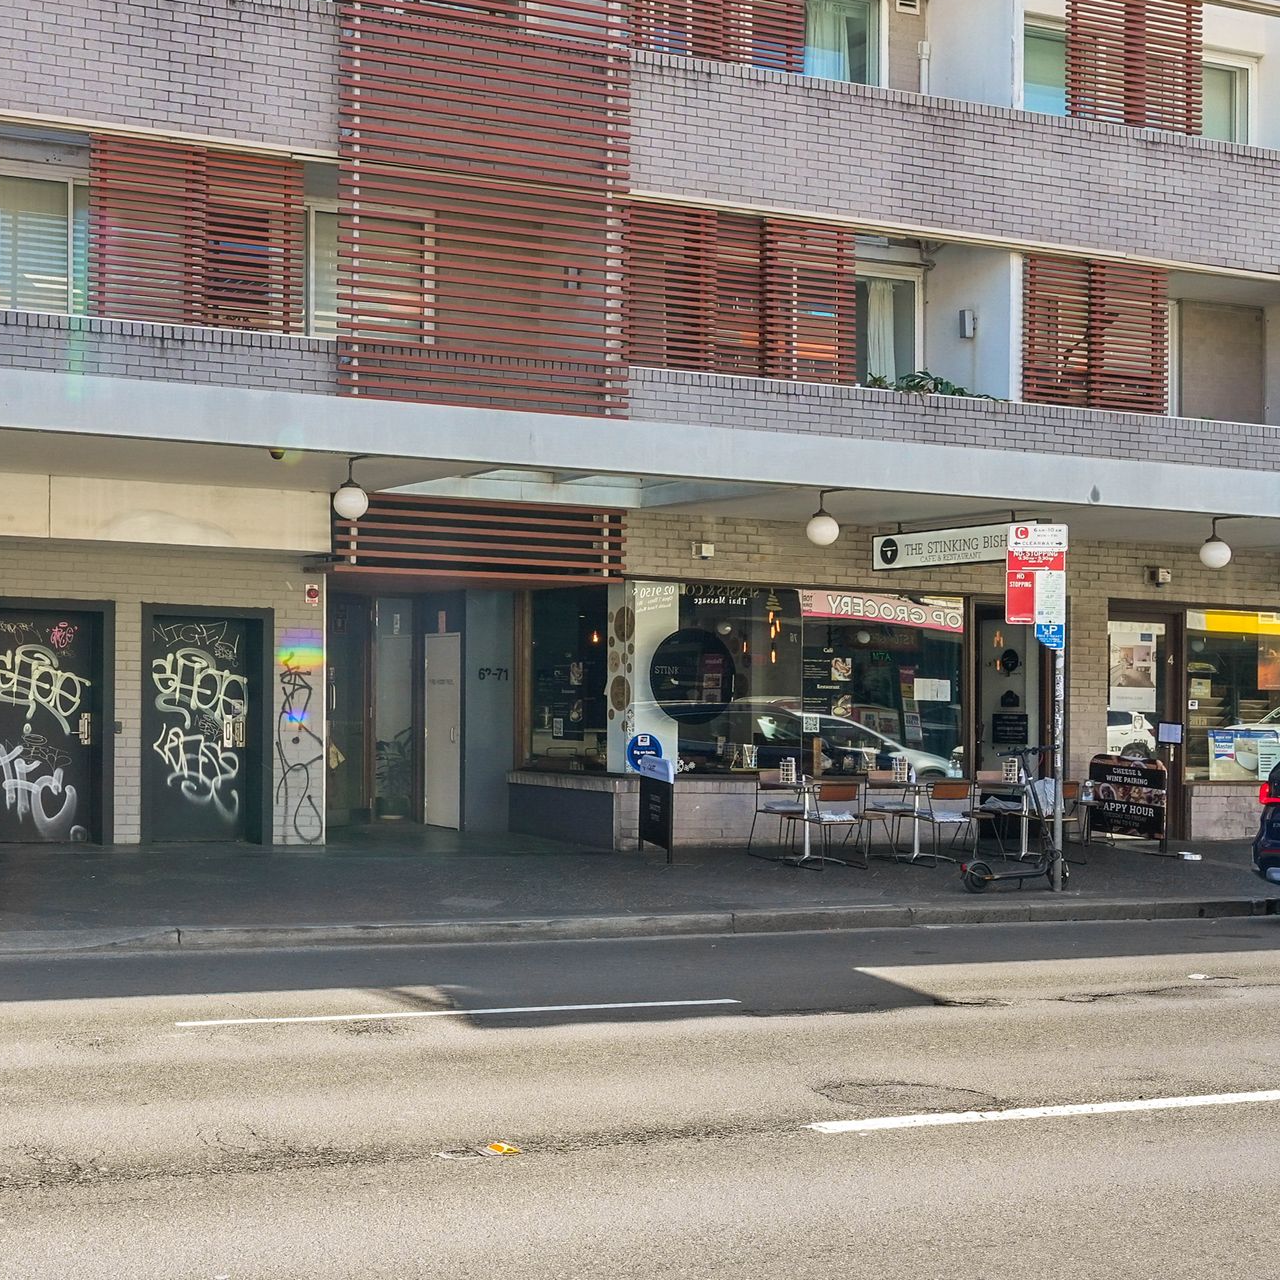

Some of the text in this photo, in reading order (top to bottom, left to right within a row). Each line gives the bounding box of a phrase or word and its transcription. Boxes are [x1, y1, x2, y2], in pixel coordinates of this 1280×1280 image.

[904, 533, 1008, 556] THE STINKING BISH
[943, 551, 982, 562] RESTAURANT
[1167, 654, 1174, 665] 4
[654, 665, 680, 675] STINK
[1112, 767, 1136, 776] CHEESE
[1106, 775, 1148, 785] WINE PAIRING
[1103, 802, 1154, 817] APPY HOUR
